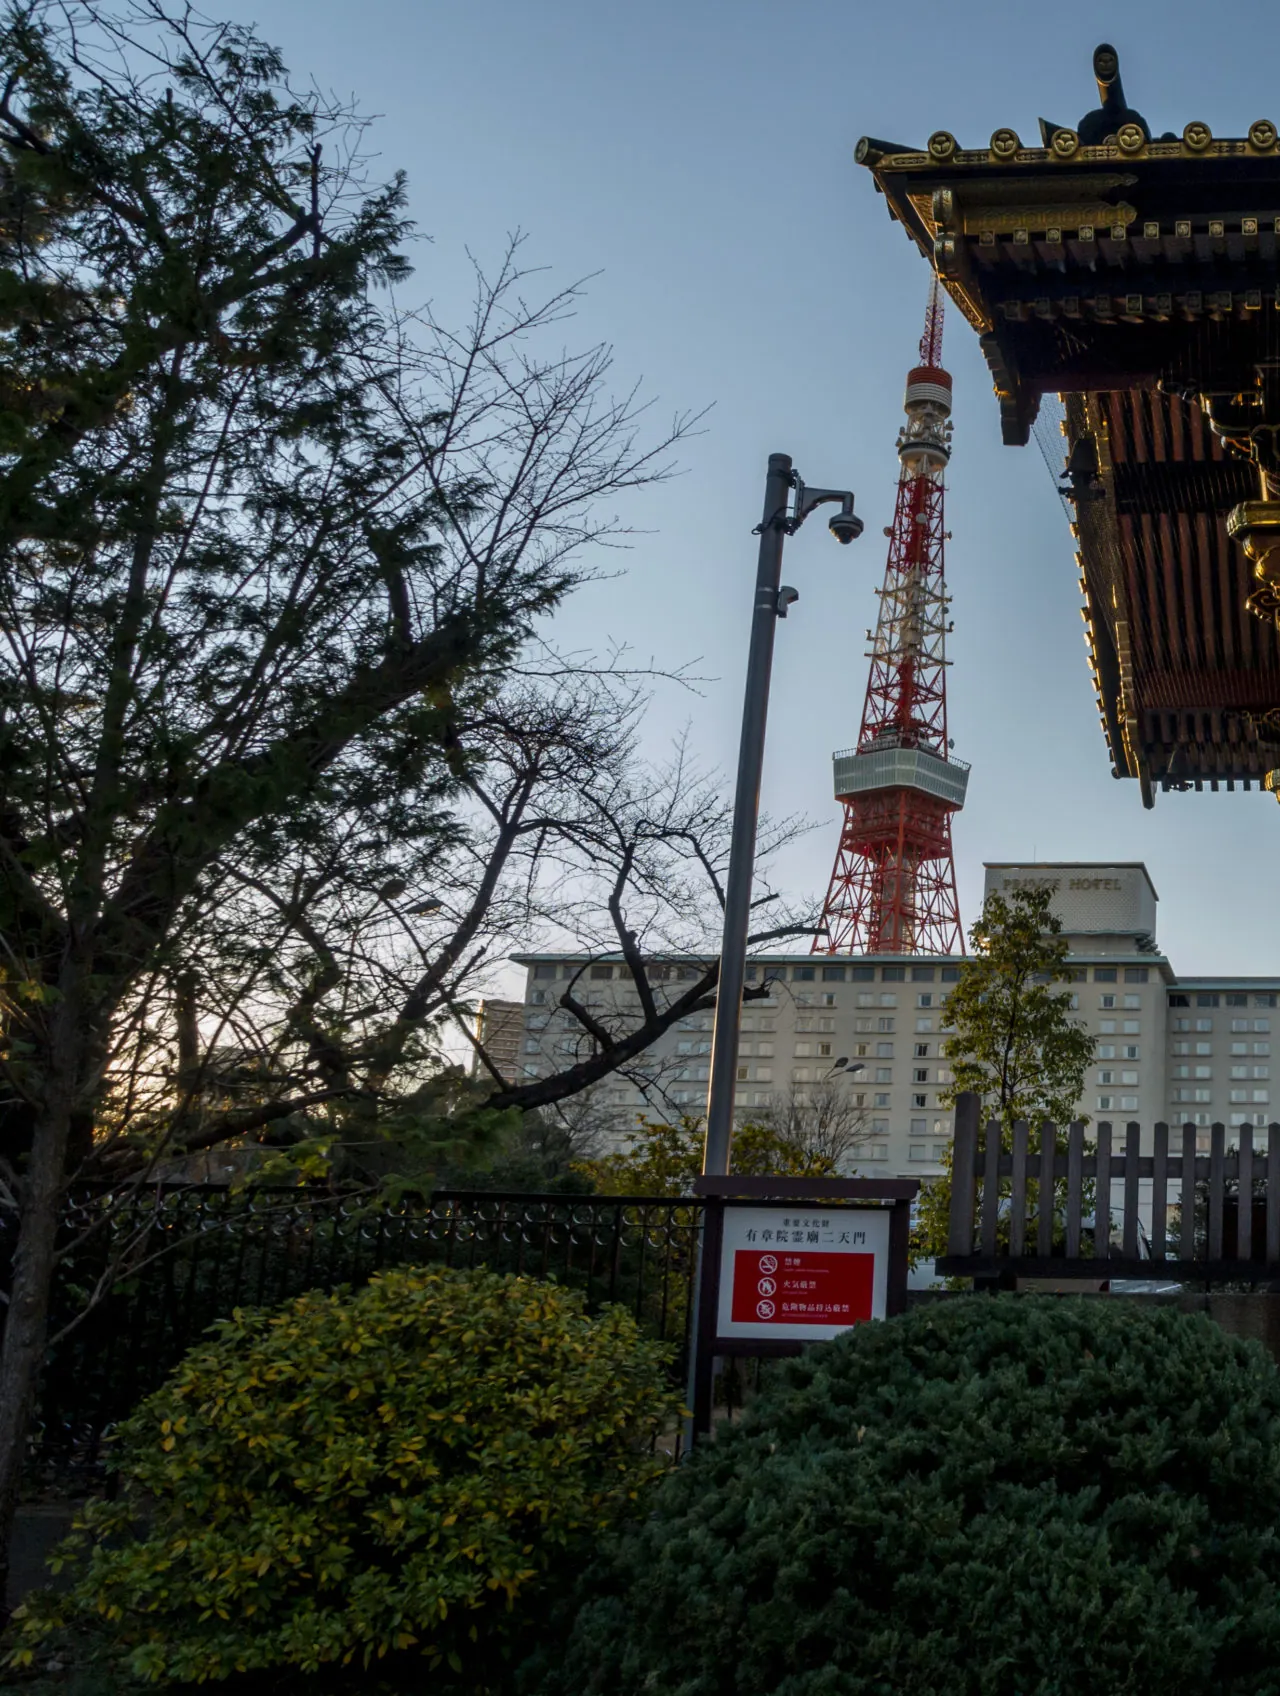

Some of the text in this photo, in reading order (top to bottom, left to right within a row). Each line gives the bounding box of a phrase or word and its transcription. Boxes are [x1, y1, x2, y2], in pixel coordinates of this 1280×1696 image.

[1069, 878, 1122, 891] HOTEL
[746, 1229, 866, 1245] 有章院霊廟二天門
[783, 1279, 817, 1289] 火気厳禁
